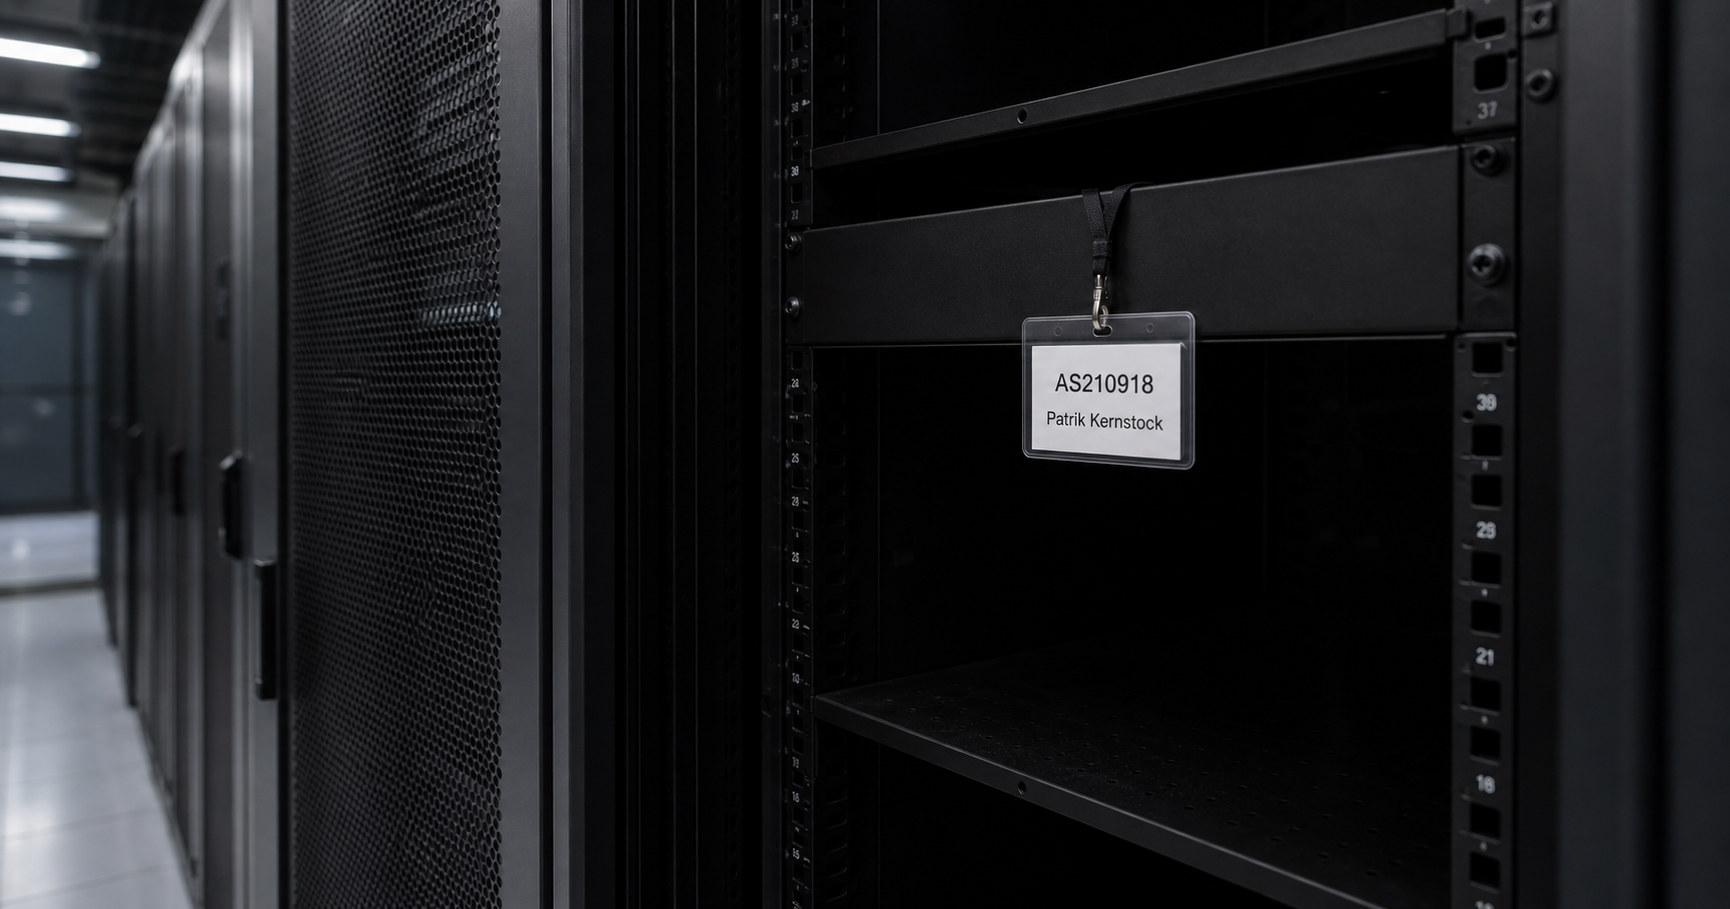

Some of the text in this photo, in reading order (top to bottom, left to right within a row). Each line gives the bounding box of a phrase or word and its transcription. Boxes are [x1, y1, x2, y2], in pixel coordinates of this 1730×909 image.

[1054, 373, 1154, 394] AS210918
[1046, 411, 1164, 431] Patrik Kernstock
[1475, 648, 1495, 665] 21
